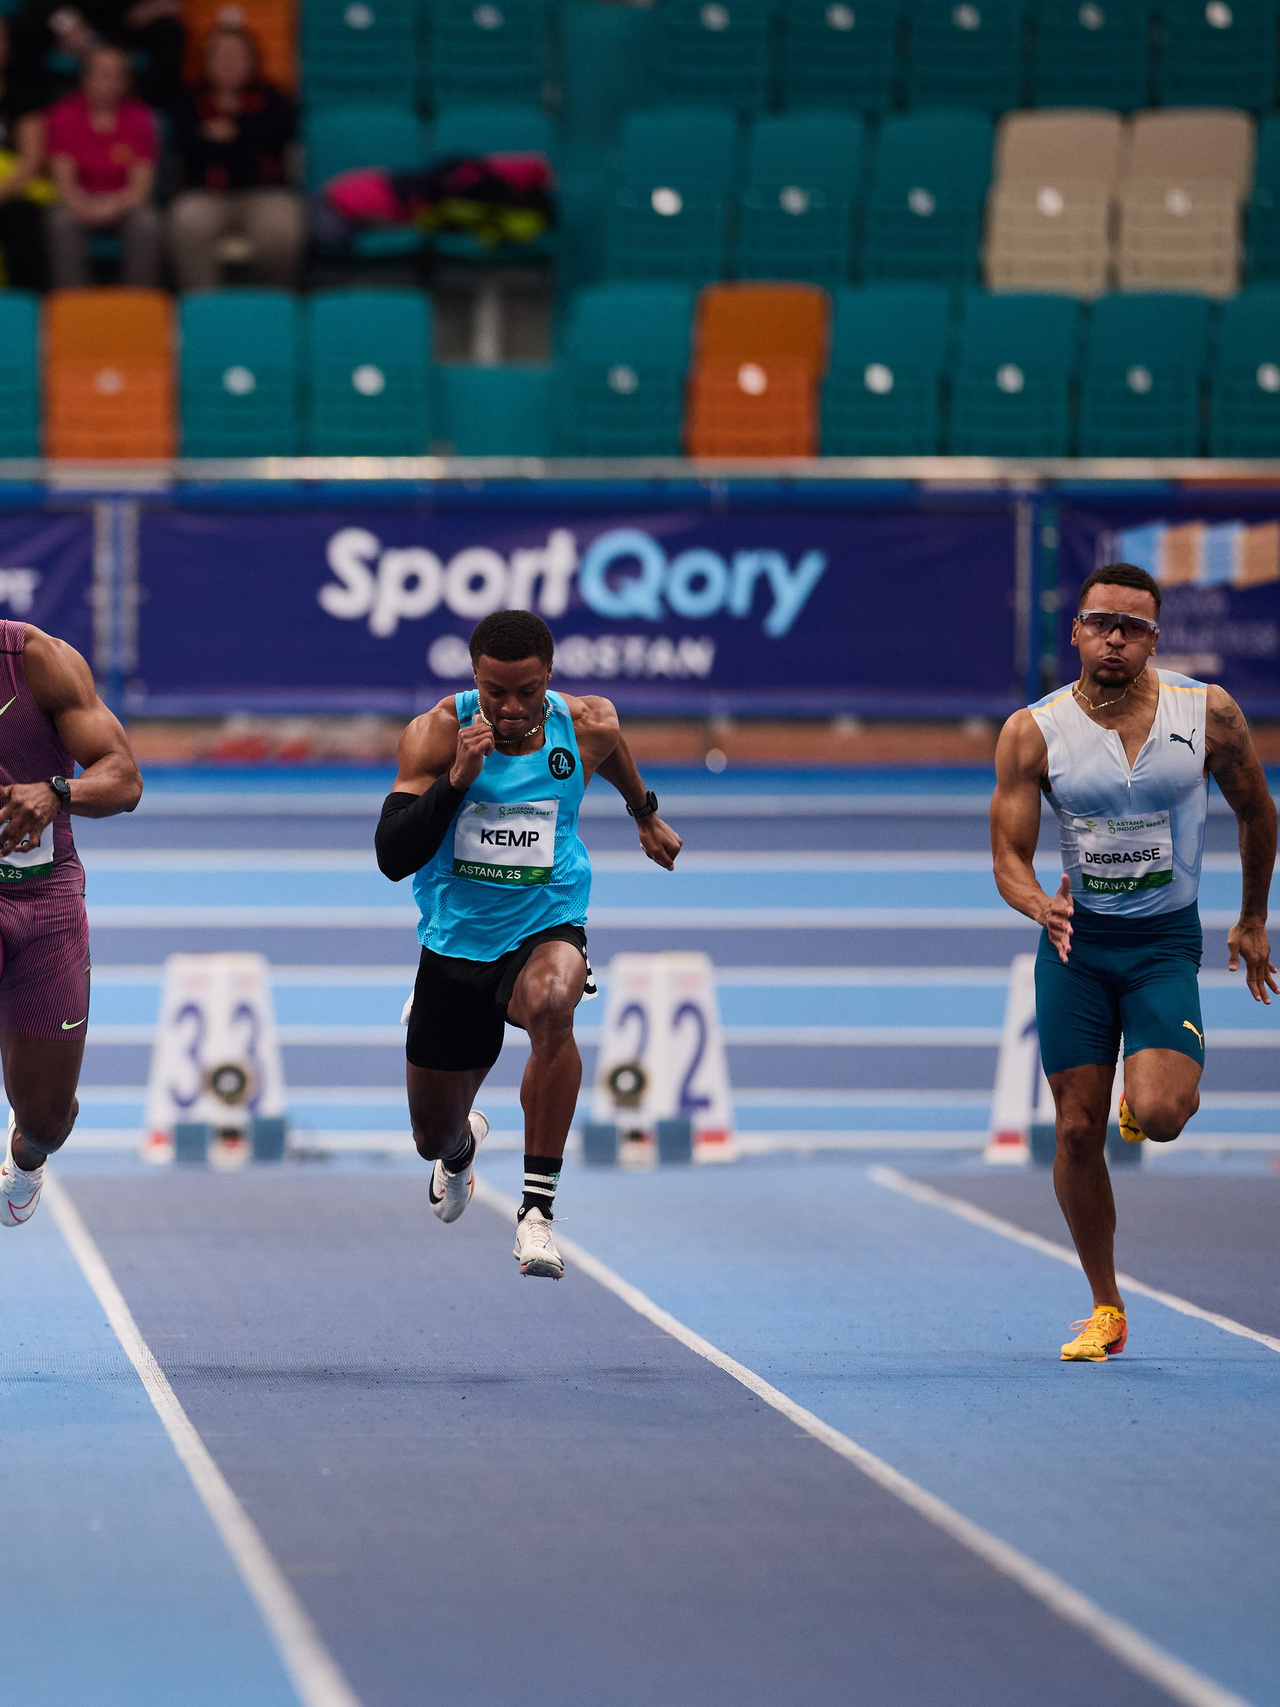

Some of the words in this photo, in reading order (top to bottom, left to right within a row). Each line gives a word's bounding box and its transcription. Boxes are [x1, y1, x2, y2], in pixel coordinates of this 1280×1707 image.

[1146, 820, 1166, 828] MEET
[480, 829, 540, 848] KEMP
[1085, 848, 1161, 865] DEGRASSE
[8, 869, 23, 879] 25
[459, 864, 503, 879] ASTANA
[506, 870, 522, 880] 25
[1087, 879, 1127, 890] ASTANA
[170, 1002, 208, 1110] 3
[672, 1002, 711, 1110] 2
